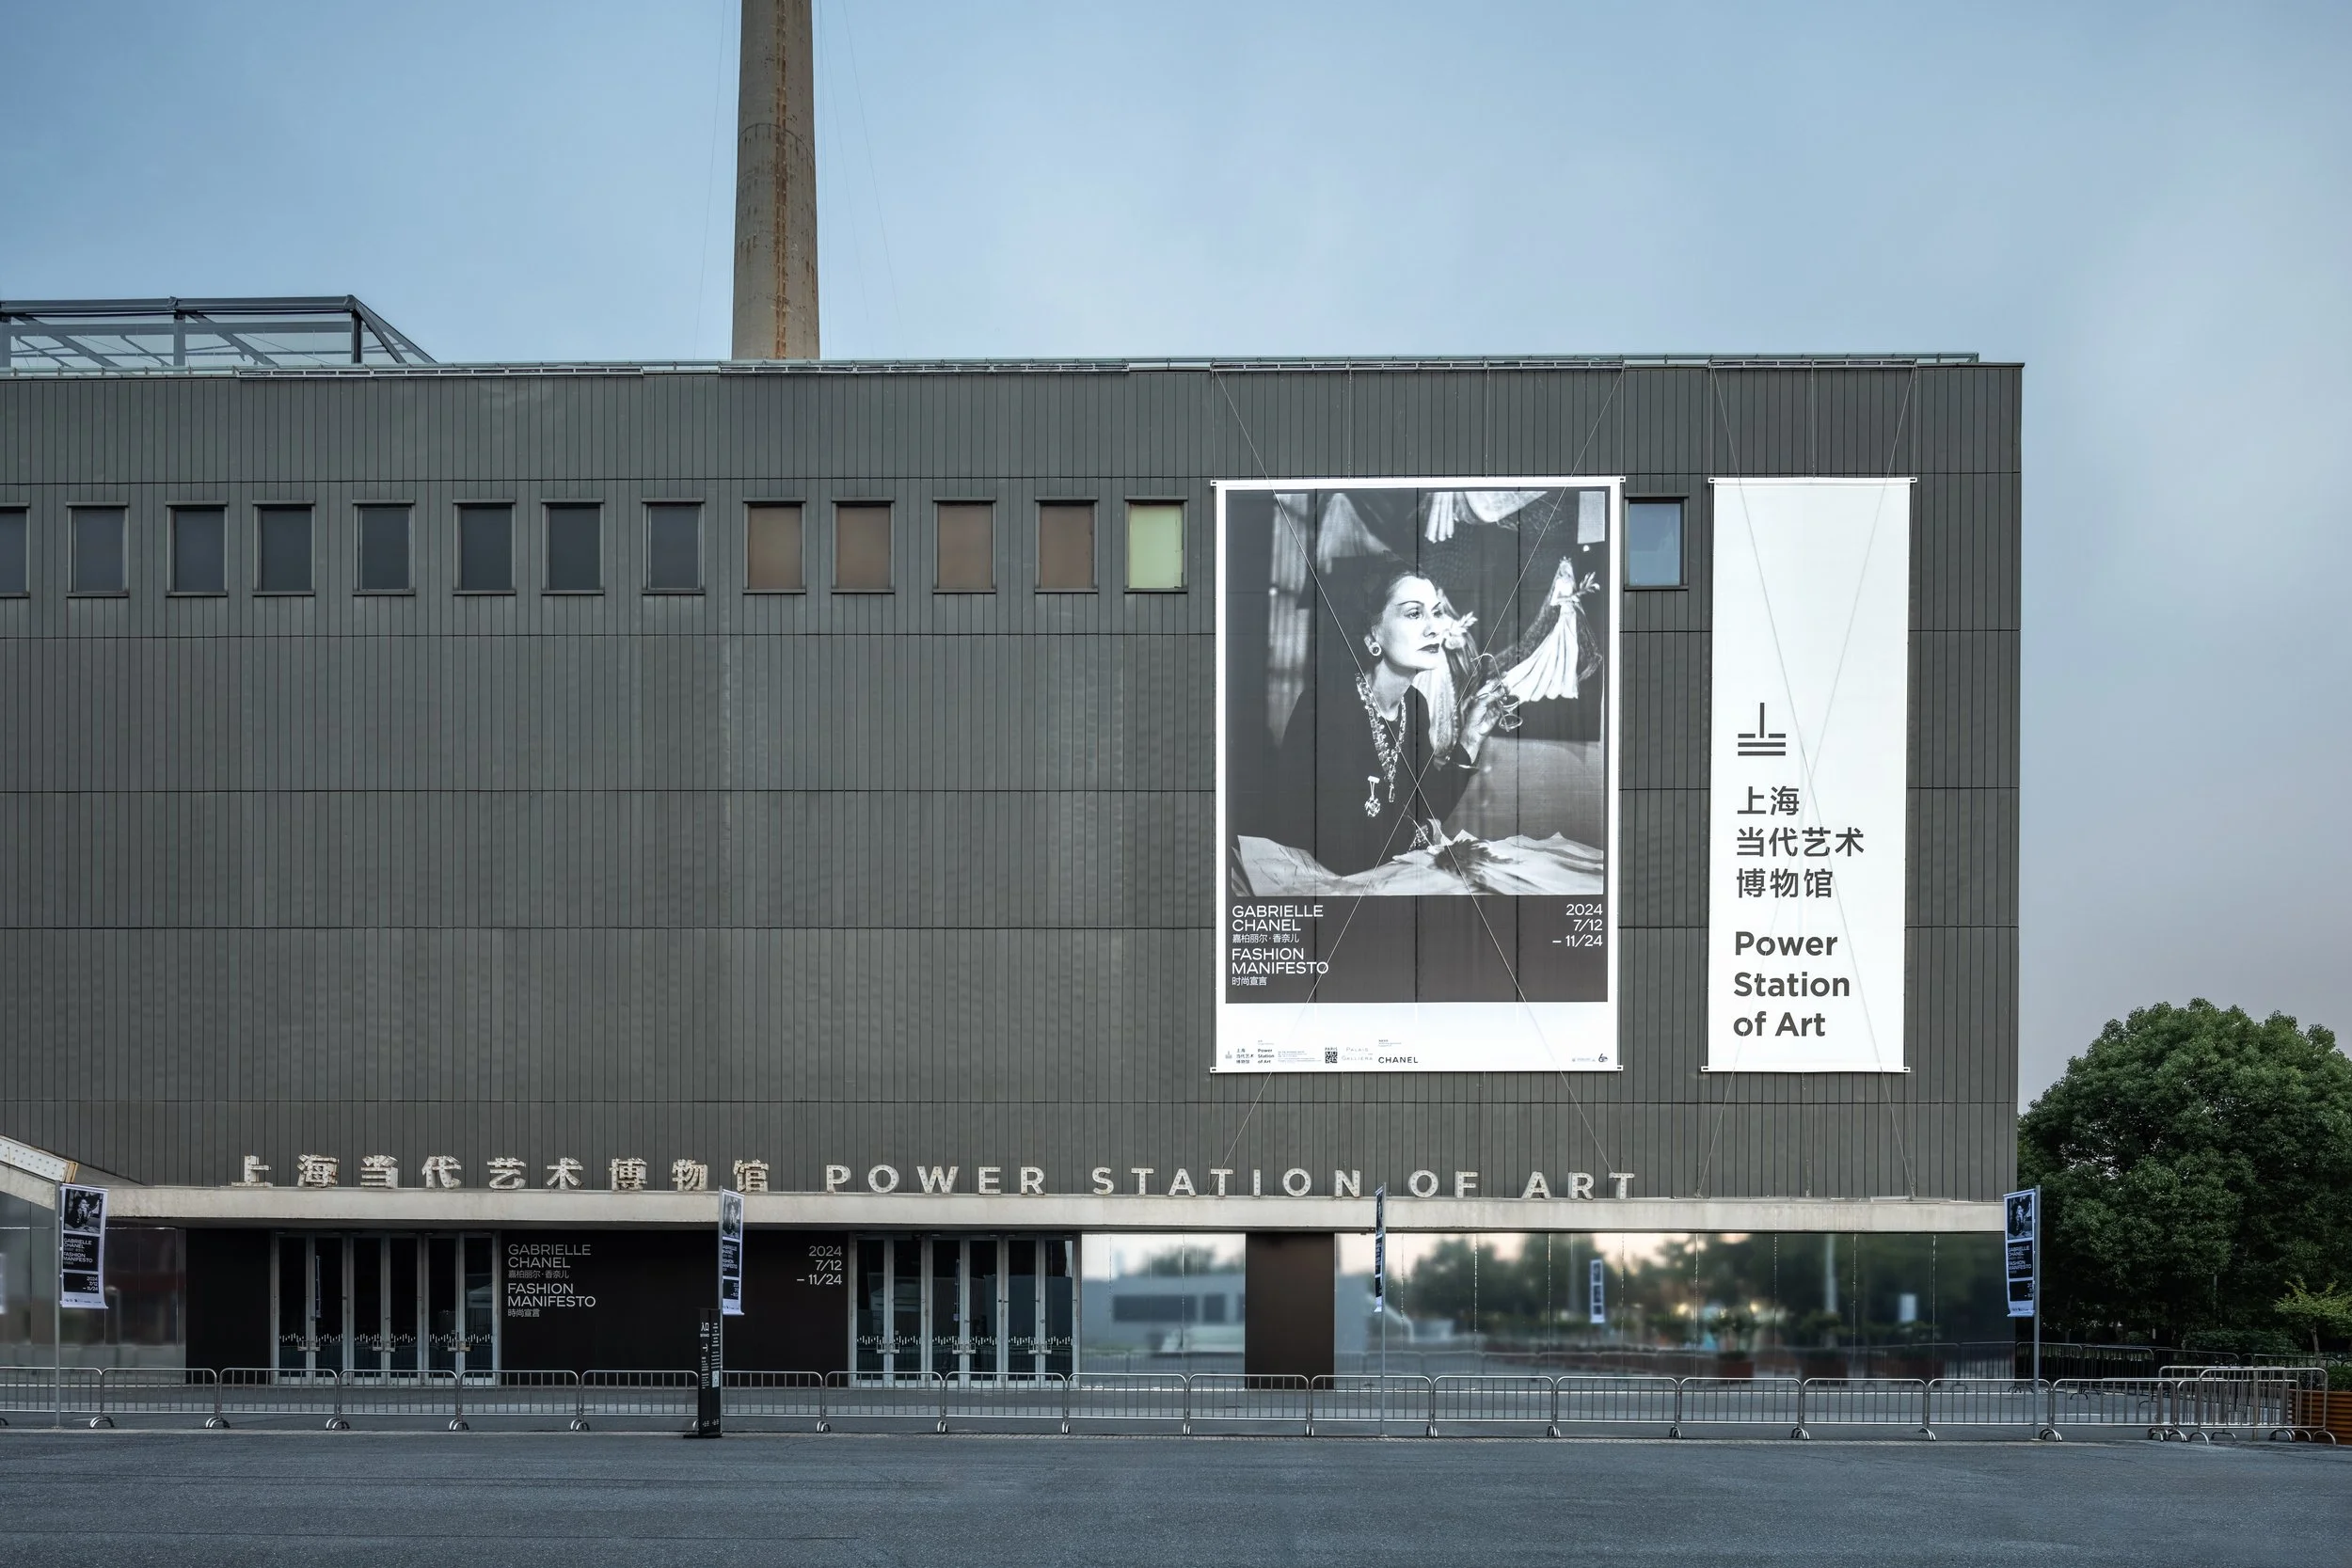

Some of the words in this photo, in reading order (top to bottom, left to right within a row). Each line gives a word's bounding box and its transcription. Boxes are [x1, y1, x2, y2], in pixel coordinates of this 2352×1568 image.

[1737, 785, 1800, 816] 上海
[1737, 827, 1865, 857] 当代艺术
[1737, 868, 1833, 898] 博物馆
[1232, 905, 1324, 918] GABRIELLE
[1565, 903, 1603, 916] 2024
[1232, 919, 1301, 931] CHANEL
[1573, 918, 1603, 932] 7/12
[1735, 931, 1838, 956] Power
[1232, 947, 1304, 960] FASHION
[1232, 961, 1328, 974] MANIFESTO
[1232, 975, 1267, 986] 时尚宣言
[1734, 972, 1850, 997] Station
[1733, 1010, 1767, 1037] of
[1775, 1012, 1826, 1037] Art
[231, 1155, 770, 1193] 上海当代艺术博物馆
[826, 1164, 1045, 1196] POWER
[1091, 1167, 1360, 1198] STATION
[1408, 1170, 1478, 1198] OF
[1521, 1171, 1635, 1200] ART
[508, 1243, 592, 1256] GABRIELLE
[809, 1245, 842, 1257] 2024
[508, 1257, 571, 1268] CHANEL
[816, 1259, 842, 1271] 7/12
[508, 1283, 574, 1294] FASHION
[508, 1295, 596, 1307] MANIFESTO
